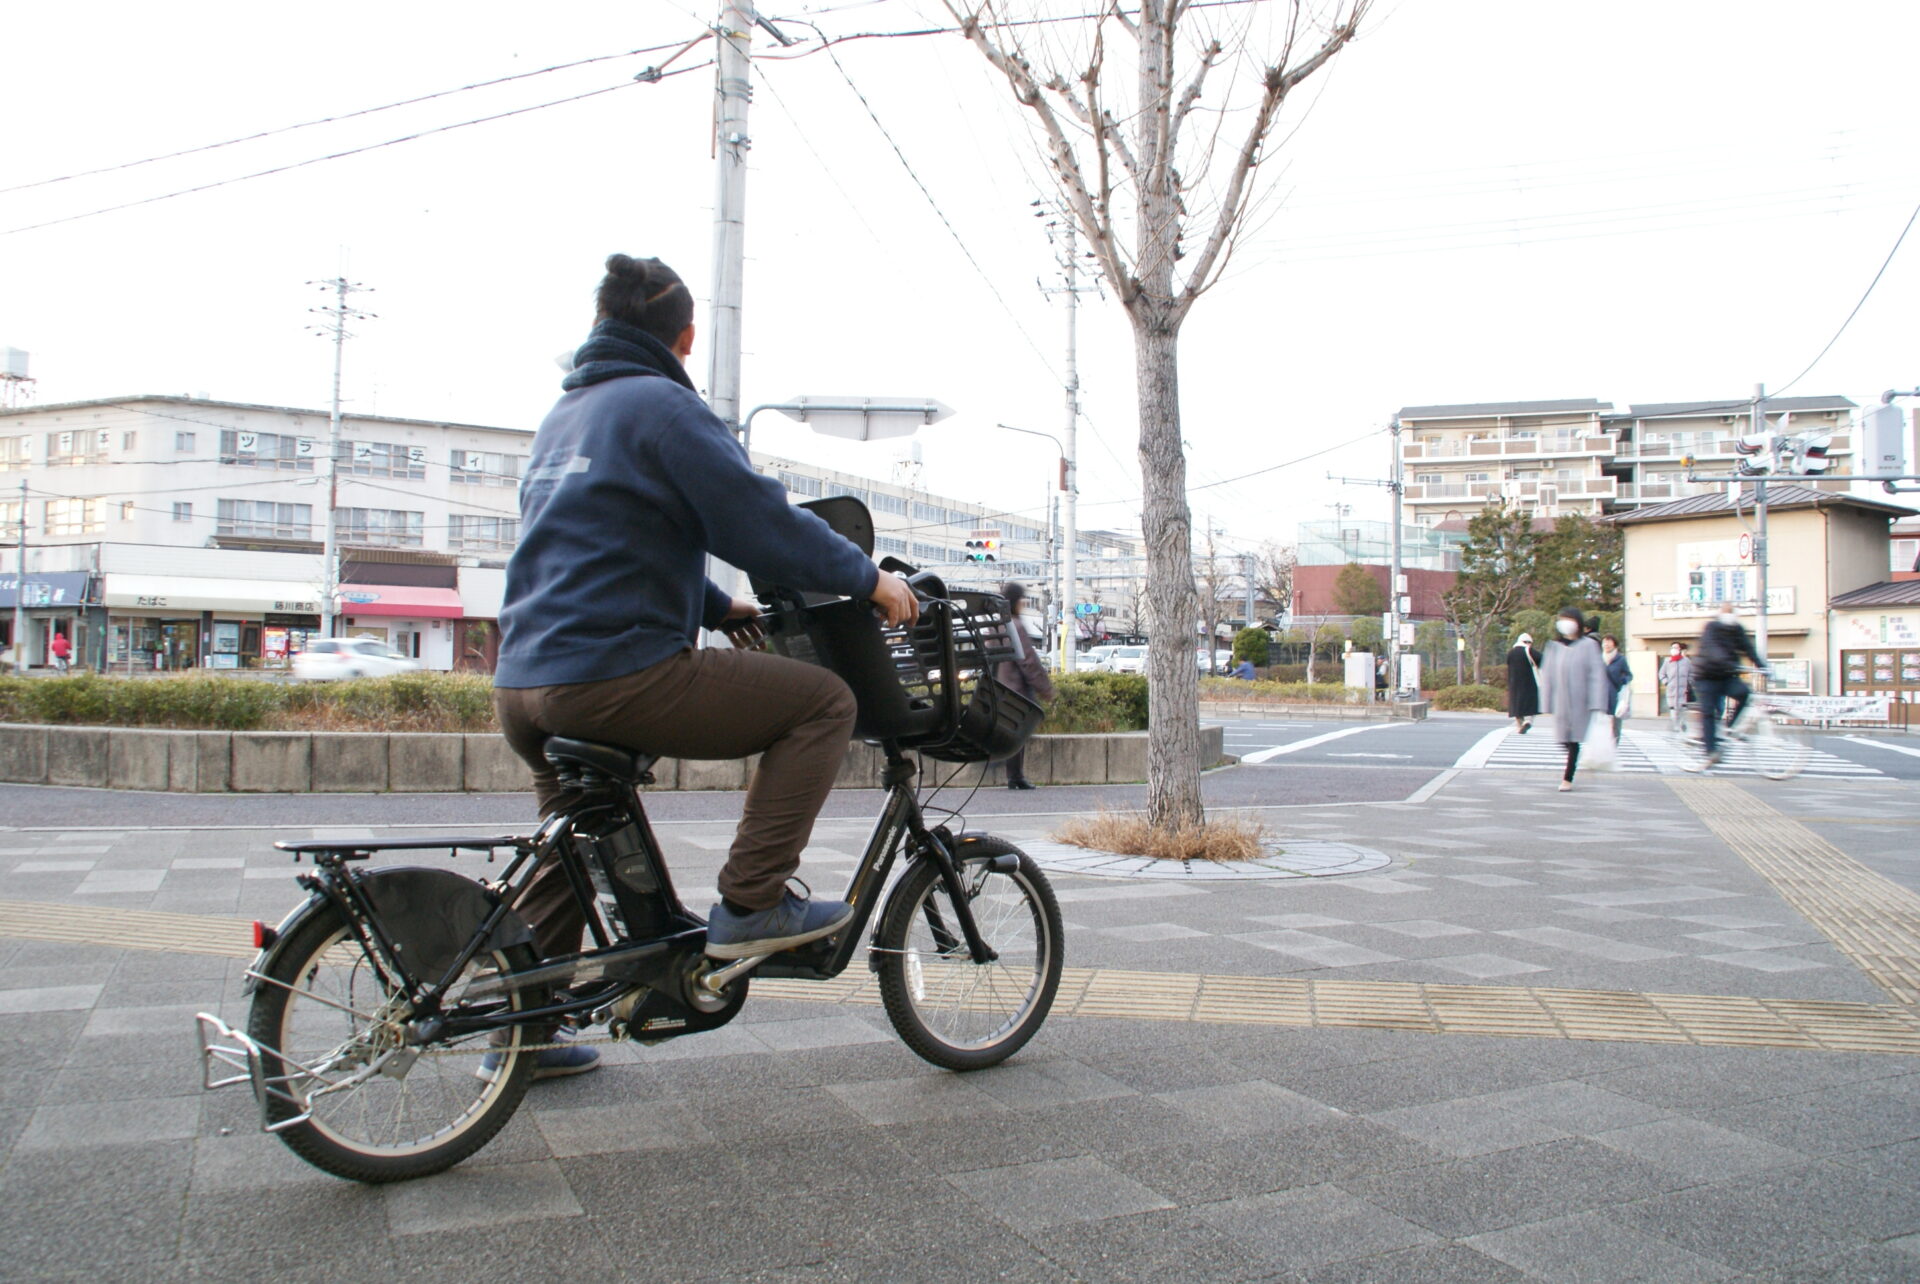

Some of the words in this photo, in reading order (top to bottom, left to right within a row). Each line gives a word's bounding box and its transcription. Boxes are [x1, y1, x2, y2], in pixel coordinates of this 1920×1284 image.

[137, 596, 167, 606] たばこ
[872, 825, 898, 872] Panasonic
